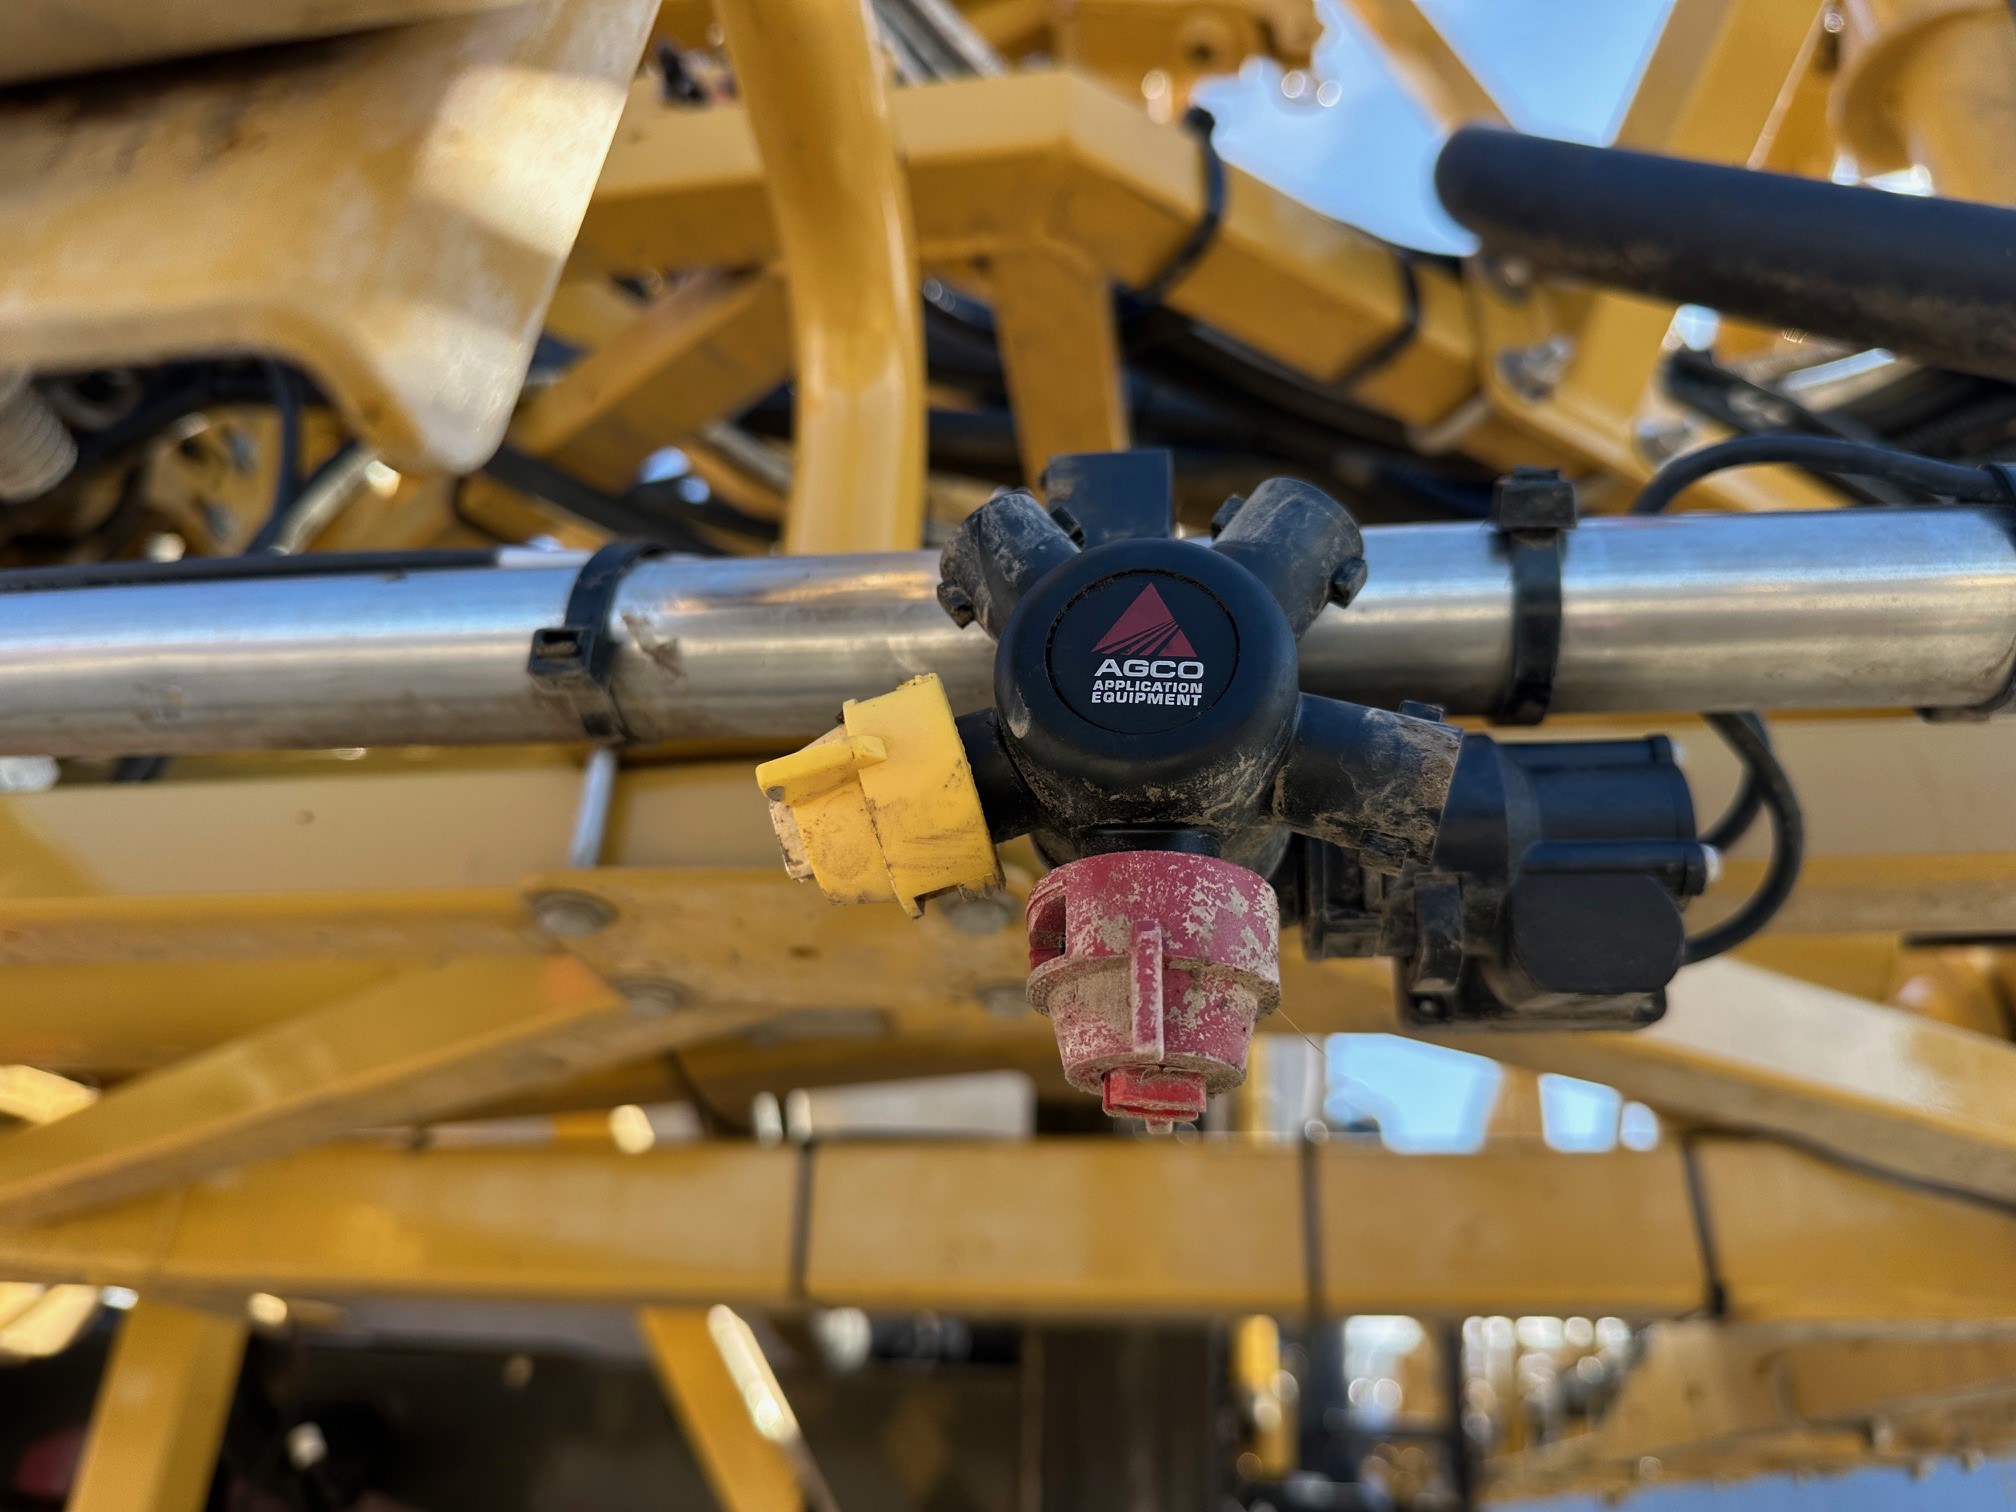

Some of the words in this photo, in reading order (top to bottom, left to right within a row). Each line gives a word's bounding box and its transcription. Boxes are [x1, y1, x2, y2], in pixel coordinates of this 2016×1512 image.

[1093, 658, 1204, 679] AGCO
[1092, 680, 1203, 694] APPLICATION
[1091, 691, 1202, 706] EQUIPMENT
